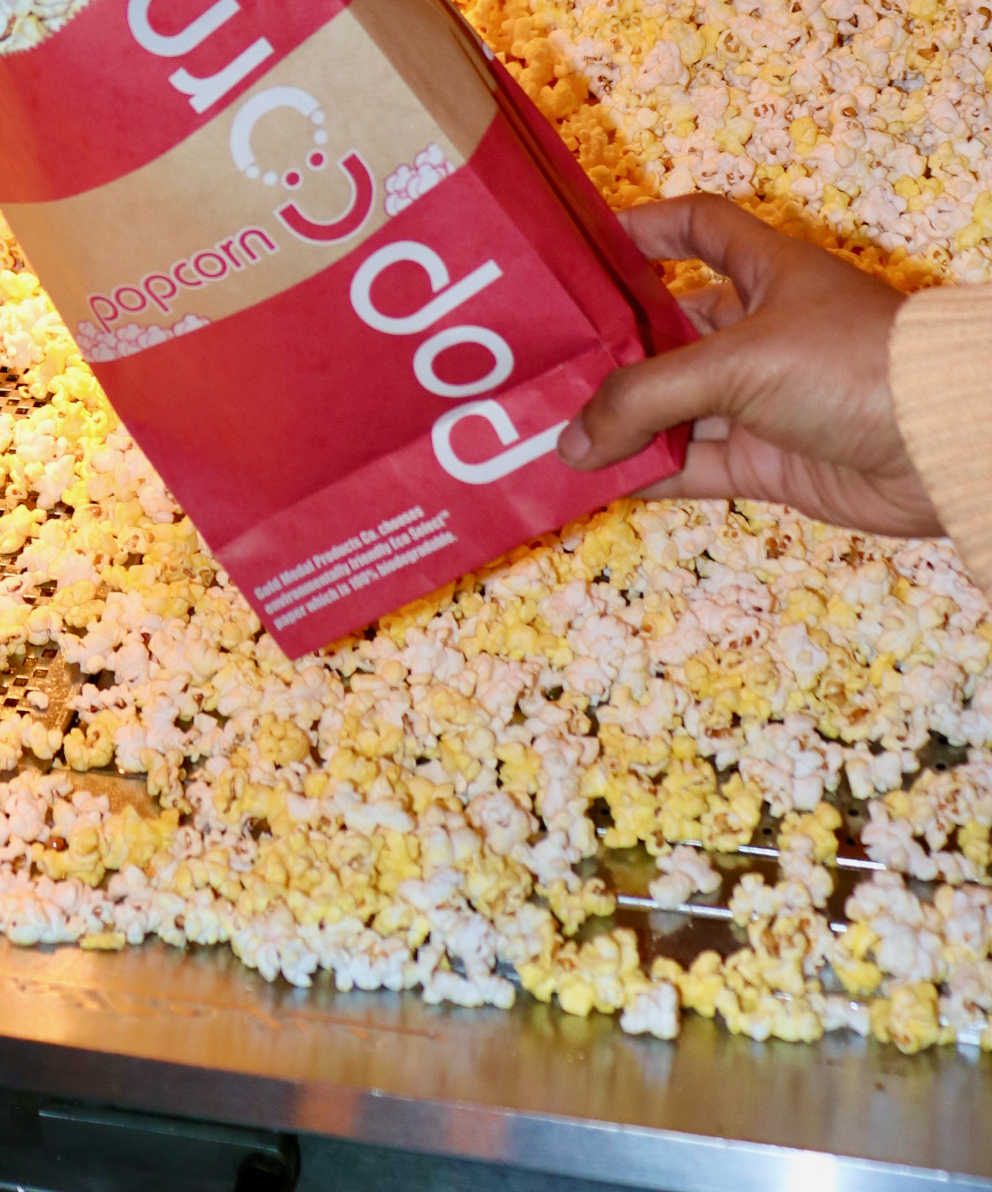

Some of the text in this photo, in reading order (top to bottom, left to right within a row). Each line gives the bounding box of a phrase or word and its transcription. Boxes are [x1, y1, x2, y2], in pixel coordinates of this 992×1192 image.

[88, 227, 278, 333] popcorn
[254, 576, 283, 601] Gold
[278, 558, 316, 587] Medal
[312, 536, 363, 569] Products
[377, 505, 425, 536] chooses
[264, 562, 351, 615] environmentally
[348, 542, 392, 570] friendly
[389, 532, 411, 550] Eco
[273, 605, 307, 631] paper
[305, 587, 340, 614] which
[337, 581, 351, 597] is
[348, 568, 380, 591] 100%
